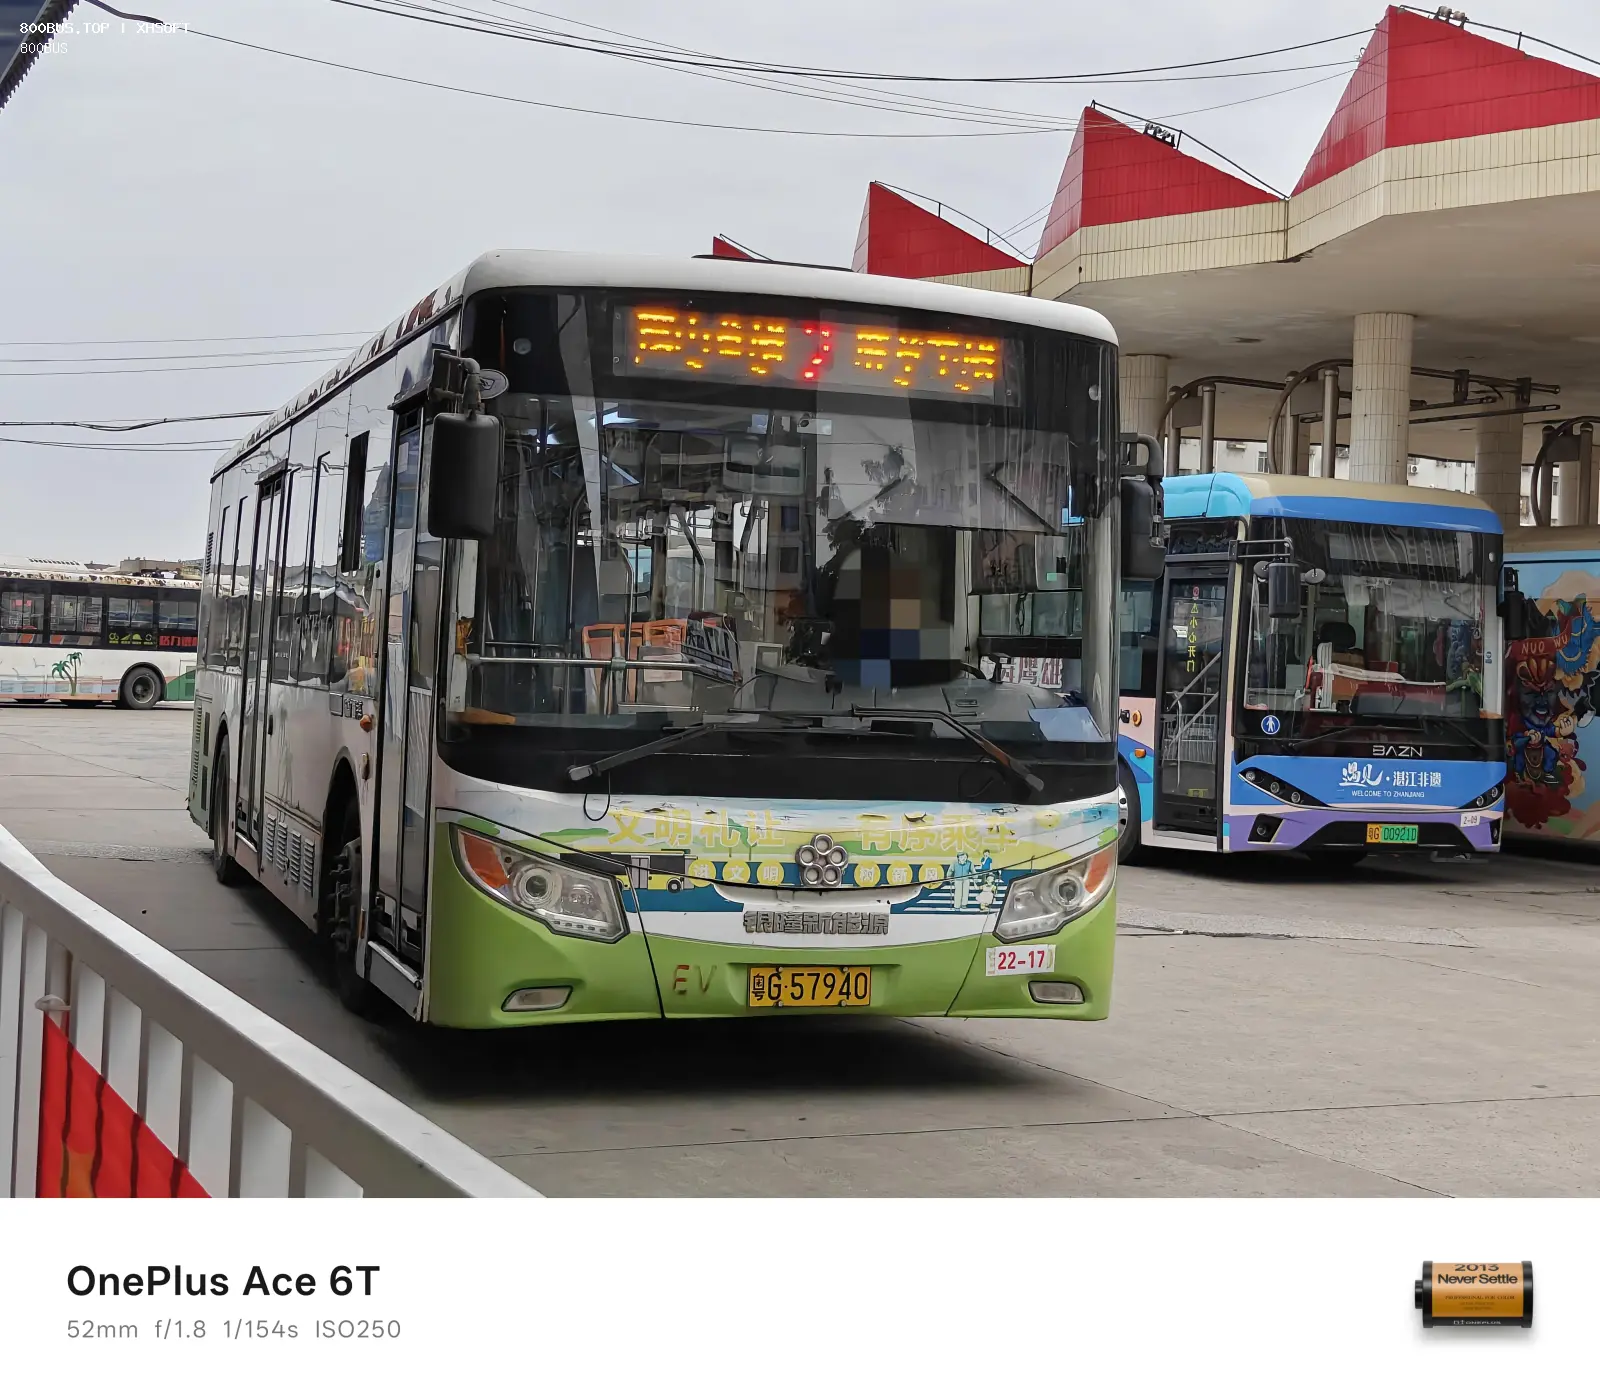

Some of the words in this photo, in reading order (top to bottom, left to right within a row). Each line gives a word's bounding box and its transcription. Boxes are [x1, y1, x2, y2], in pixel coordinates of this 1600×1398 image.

[1372, 744, 1423, 757] BAZN
[1351, 789, 1382, 798] WELCOME
[1383, 790, 1392, 798] TO
[1393, 790, 1425, 798] ZHANJIANG
[608, 806, 786, 849] 文明礼让
[743, 910, 890, 935] 银隆新能源
[997, 950, 1046, 970] 22-17
[672, 964, 718, 995] EV
